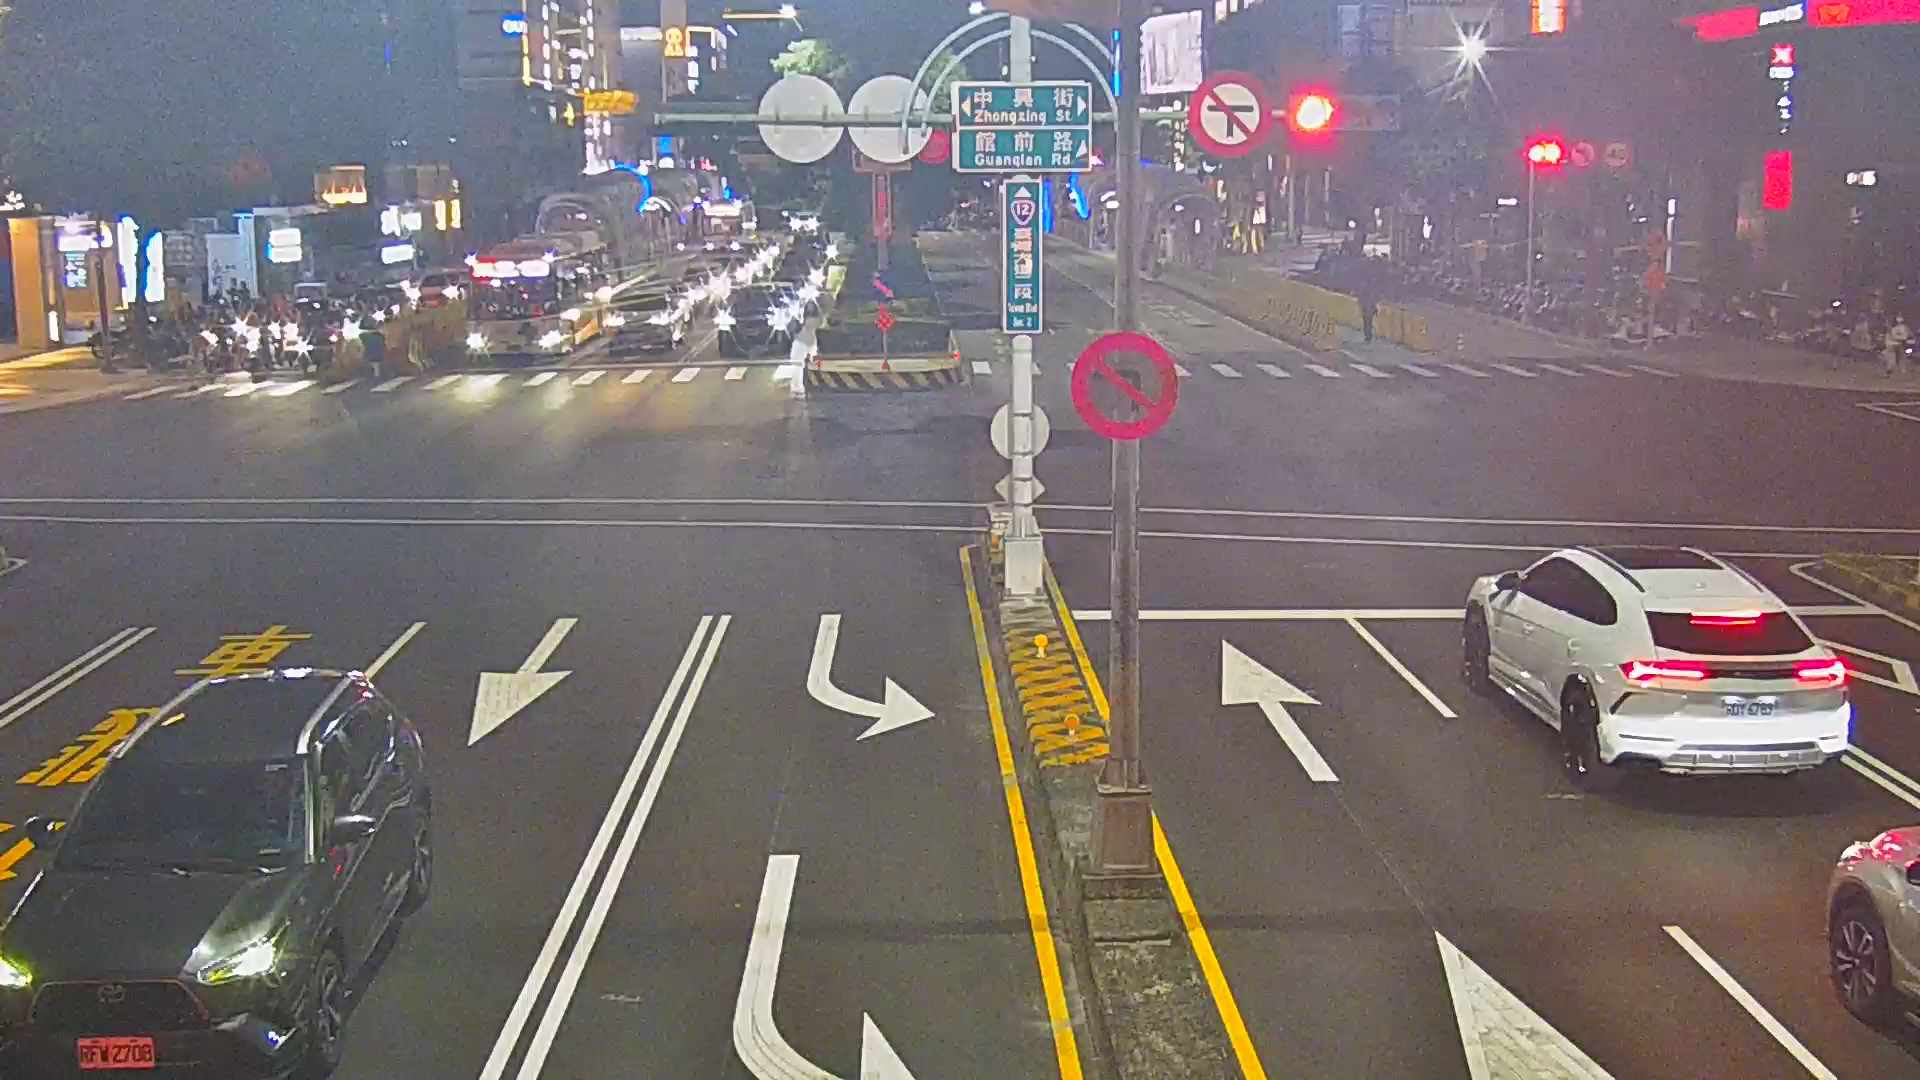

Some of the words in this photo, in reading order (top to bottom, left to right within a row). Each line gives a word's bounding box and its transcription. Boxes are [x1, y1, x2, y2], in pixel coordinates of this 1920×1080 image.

[974, 110, 1047, 125] Zhongxing
[1056, 110, 1072, 122] St
[975, 131, 1073, 152] 館前路
[974, 153, 1043, 167] Guanqian
[1051, 153, 1071, 166] Rd
[1016, 204, 1030, 216] 12
